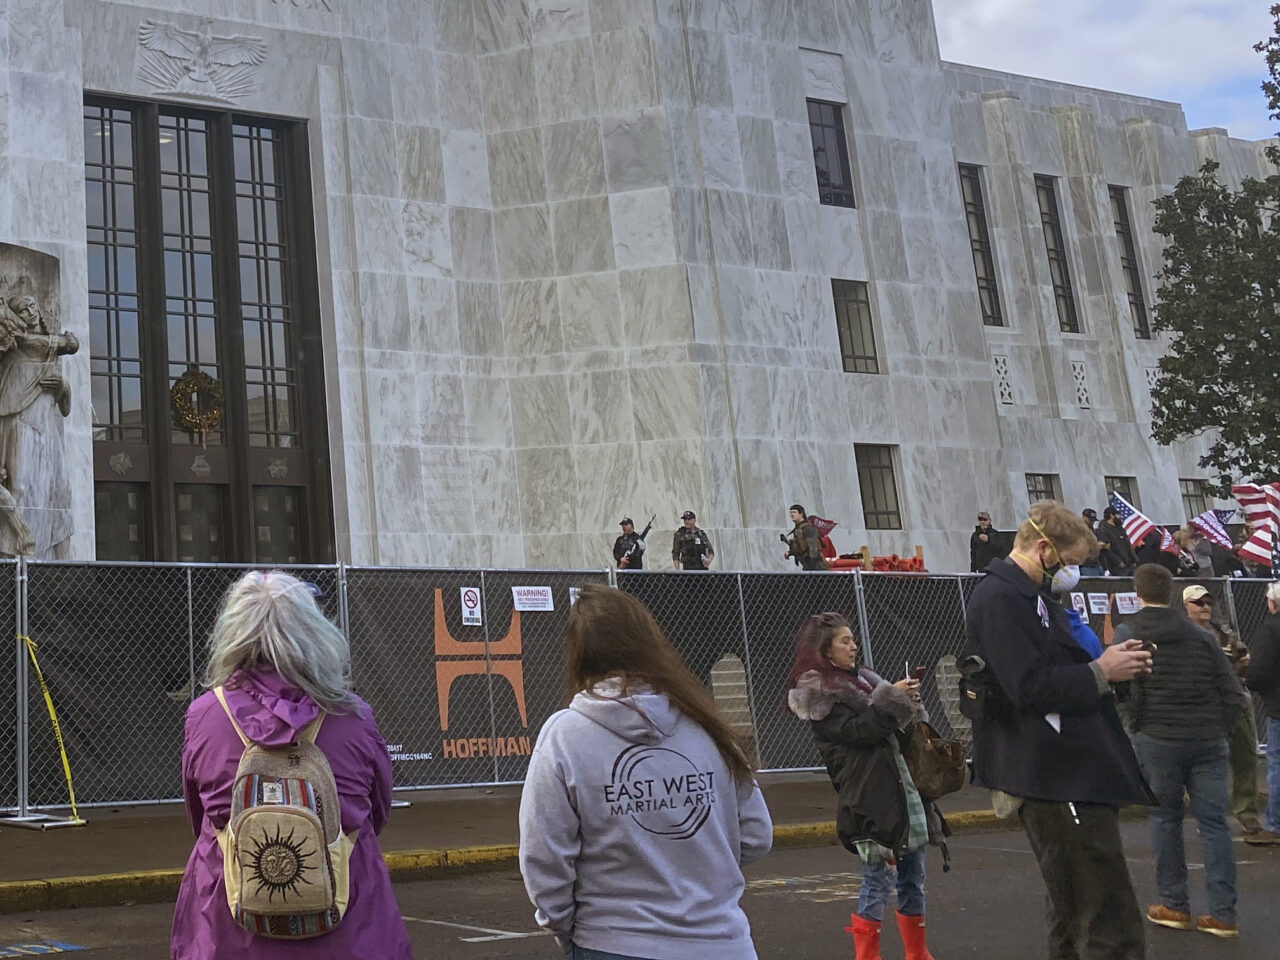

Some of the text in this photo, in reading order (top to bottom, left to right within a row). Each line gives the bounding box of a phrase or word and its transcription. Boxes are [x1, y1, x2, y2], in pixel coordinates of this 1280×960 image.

[515, 589, 549, 598] WARNING!
[441, 736, 532, 759] HOFFMAN
[603, 771, 715, 803] EAST WEST
[610, 791, 716, 817] MARTIAL ARTS
